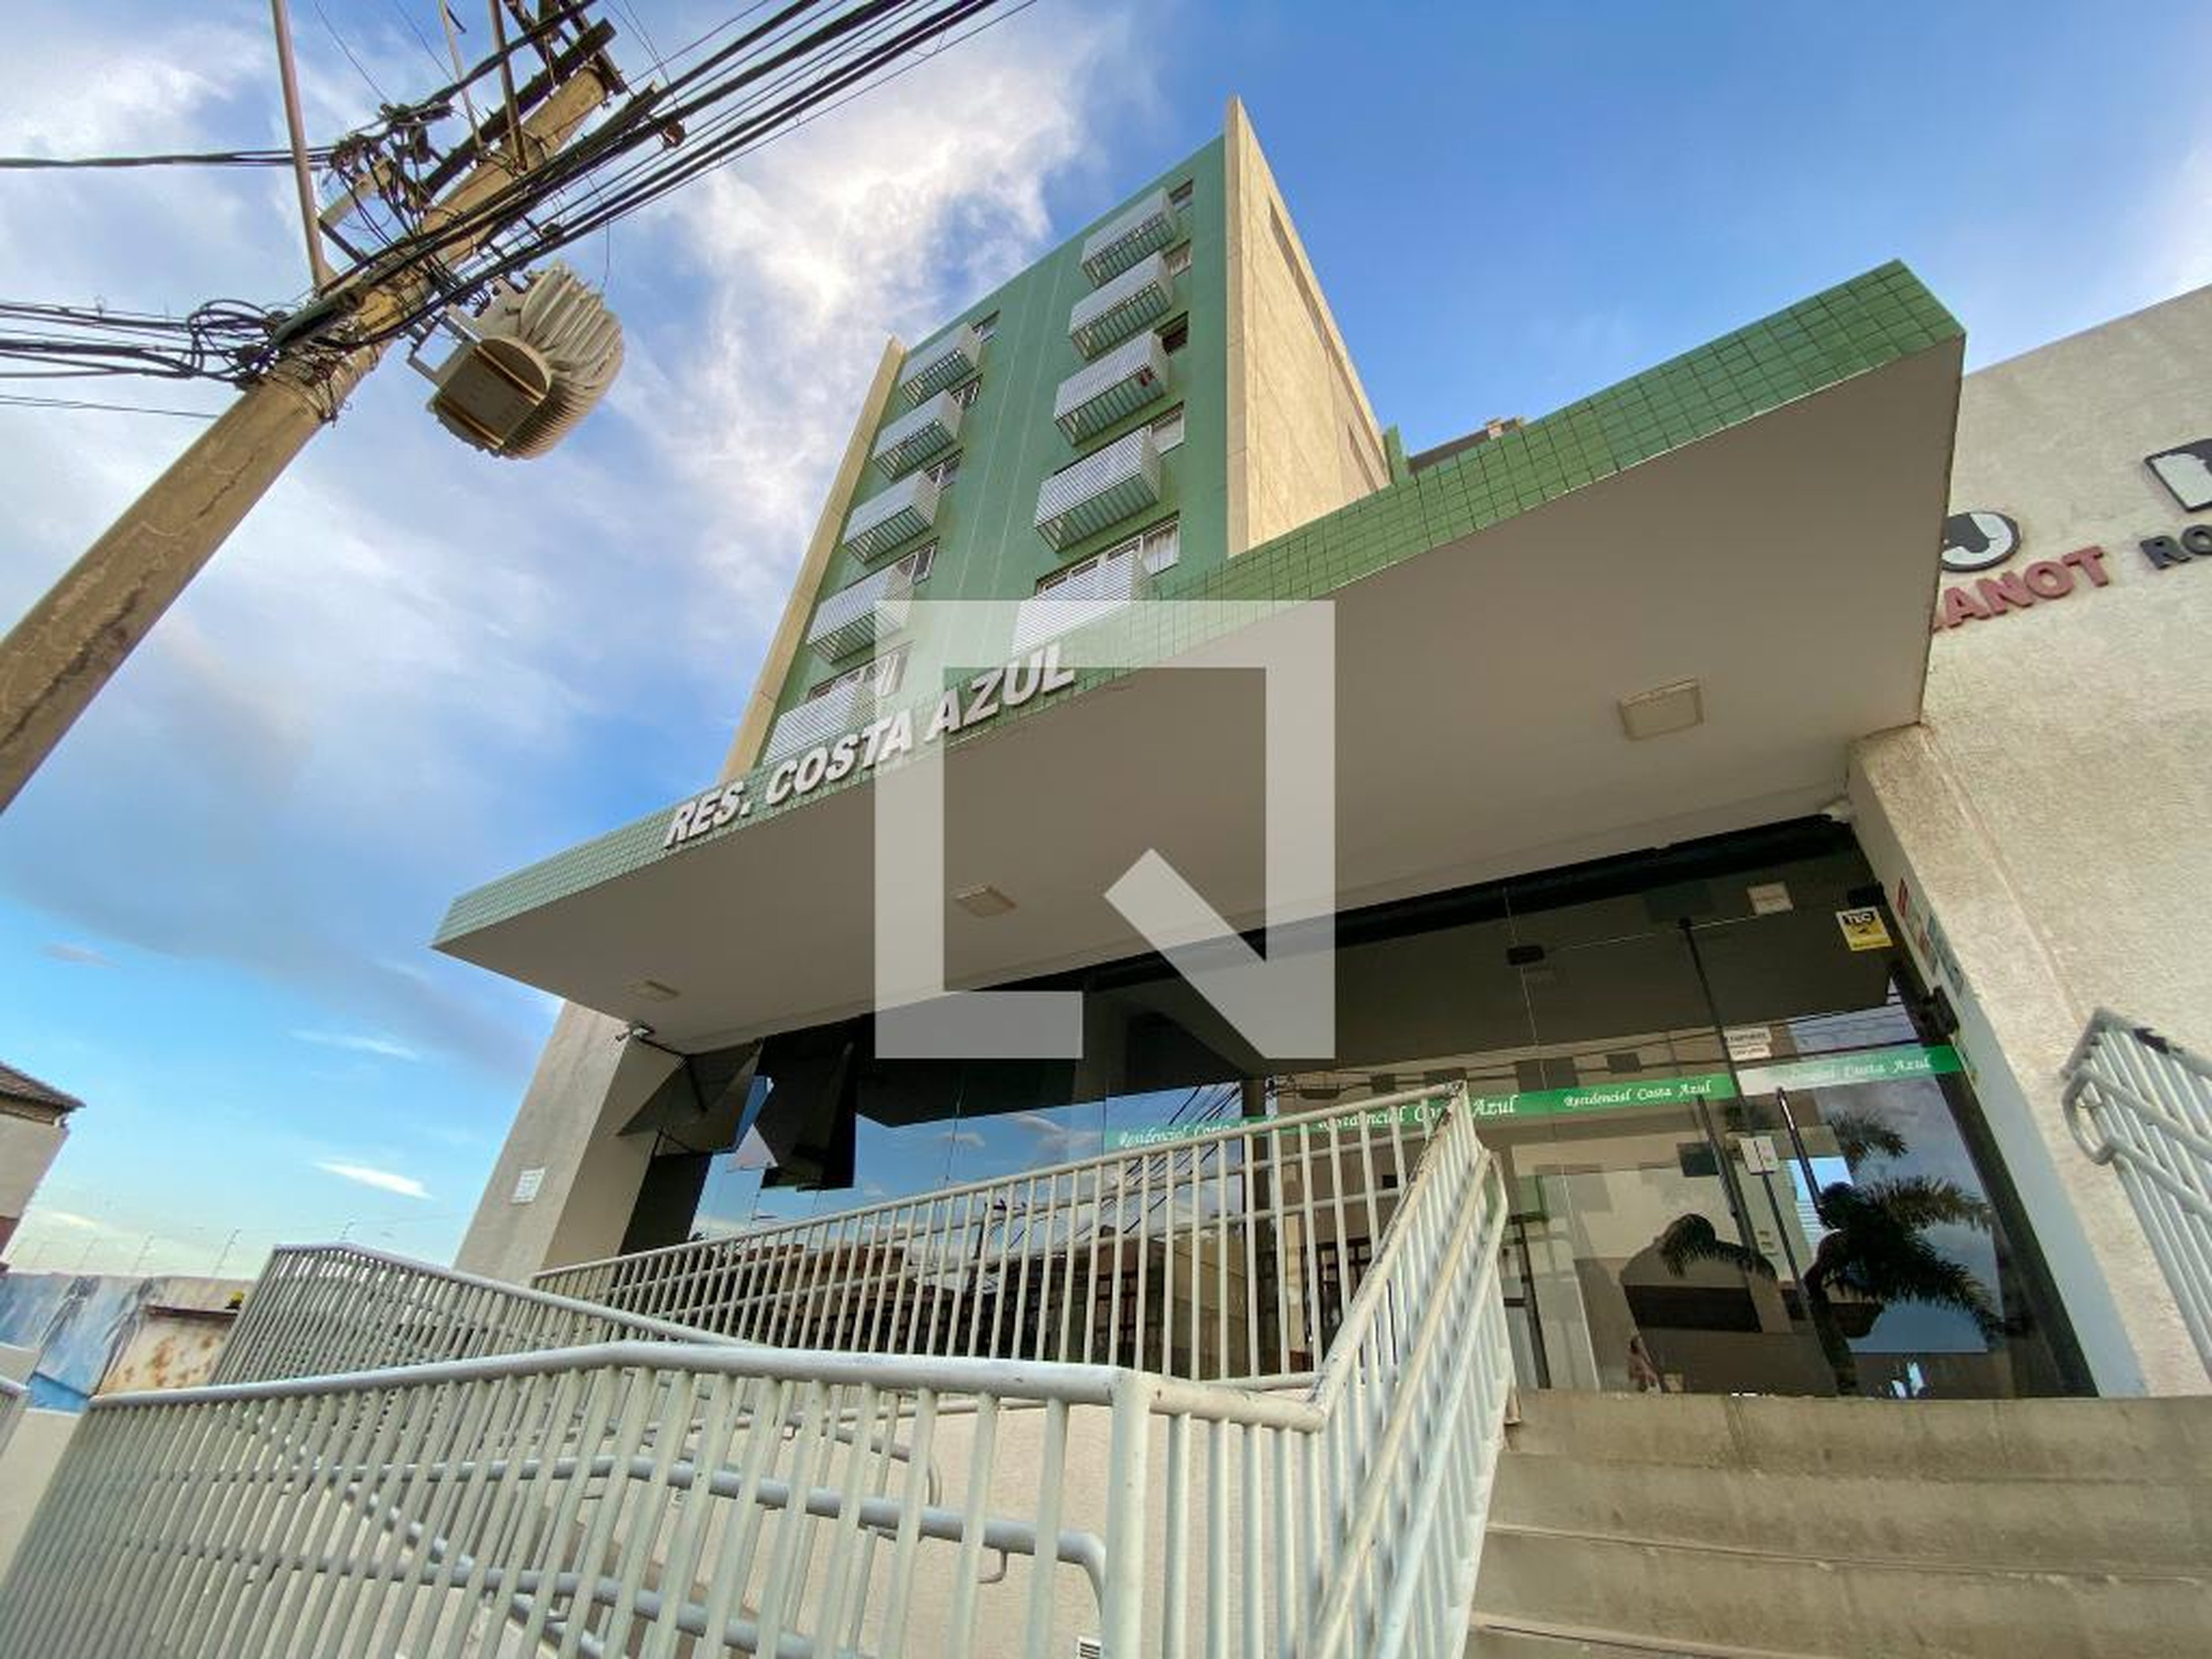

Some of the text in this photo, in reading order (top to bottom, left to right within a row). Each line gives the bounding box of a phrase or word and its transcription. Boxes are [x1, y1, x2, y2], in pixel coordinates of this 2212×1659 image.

[1933, 545, 2109, 632] ANOT
[662, 641, 1076, 848] RES. COSTA AZUL
[1472, 1094, 1519, 1117] Azul
[1563, 1079, 1712, 1108] Residencial Costa Azul
